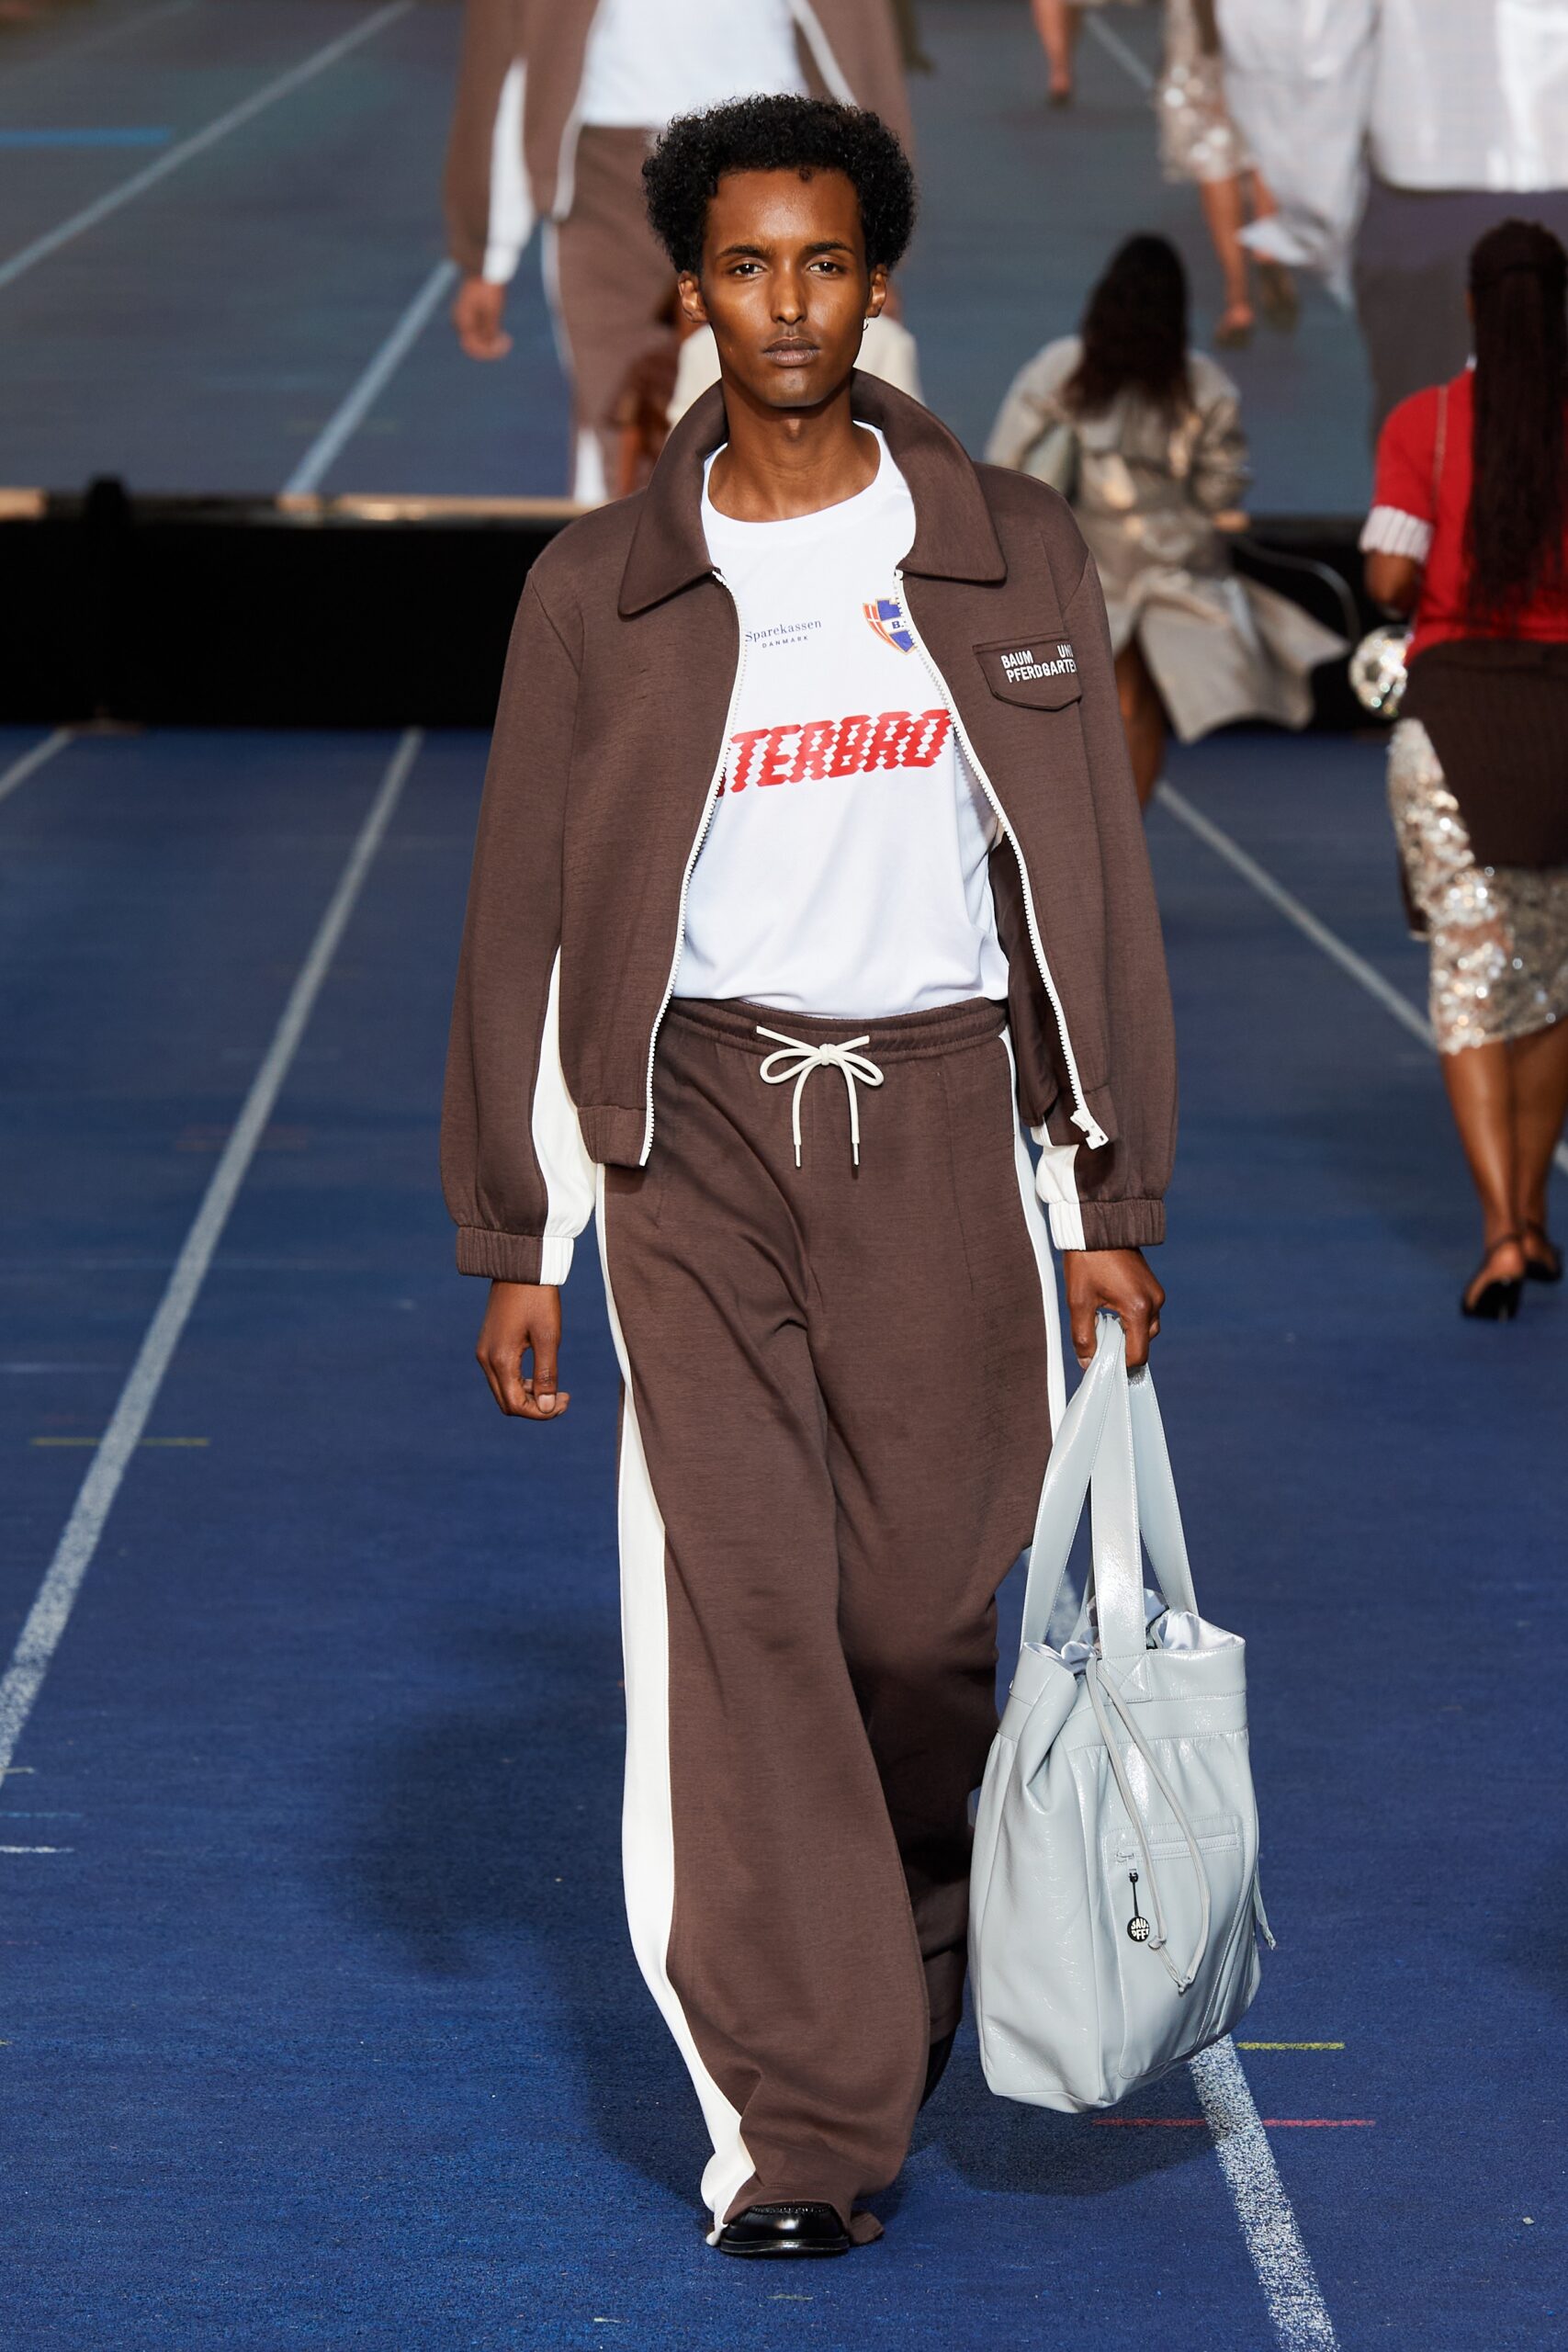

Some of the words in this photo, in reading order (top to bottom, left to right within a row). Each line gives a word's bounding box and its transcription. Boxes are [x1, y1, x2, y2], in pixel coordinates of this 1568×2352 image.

[745, 620, 822, 642] Sparekassen
[761, 636, 808, 649] DANMARK
[1000, 650, 1033, 669] BAUM
[1006, 659, 1077, 683] PFERDGARTE
[716, 709, 952, 797] TERBRO
